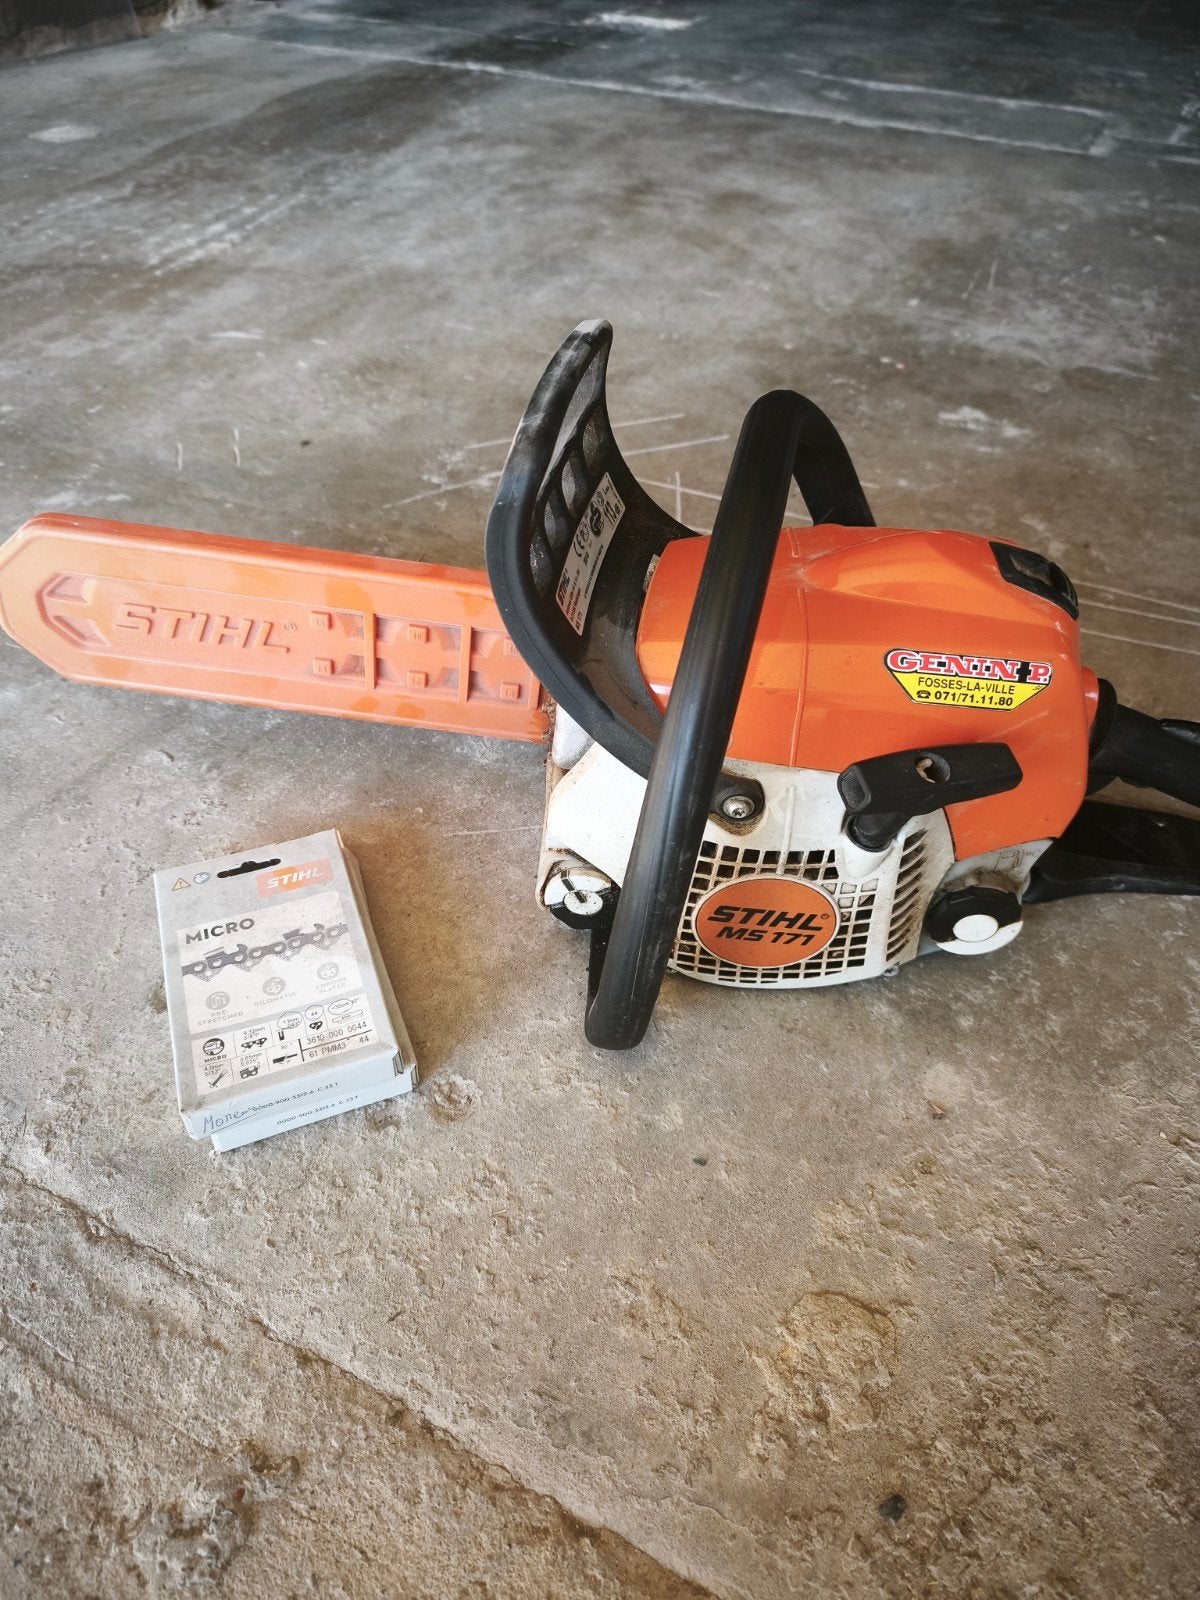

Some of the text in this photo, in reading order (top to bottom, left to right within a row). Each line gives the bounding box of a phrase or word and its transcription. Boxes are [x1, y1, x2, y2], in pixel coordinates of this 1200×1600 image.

[113, 602, 291, 654] STIHL
[887, 650, 1051, 684] GENIN P.
[917, 676, 1016, 696] FOSSES-LA-VILLE
[934, 690, 1014, 707] 071/71.11.80
[266, 867, 324, 890] STIHL
[707, 905, 823, 932] STIHL
[185, 918, 256, 945] MICRO
[716, 926, 816, 946] MS 171
[306, 1020, 367, 1046] 3610 000 0044
[204, 1054, 227, 1063] MICRO
[308, 1035, 370, 1059] 61 PMM3 44
